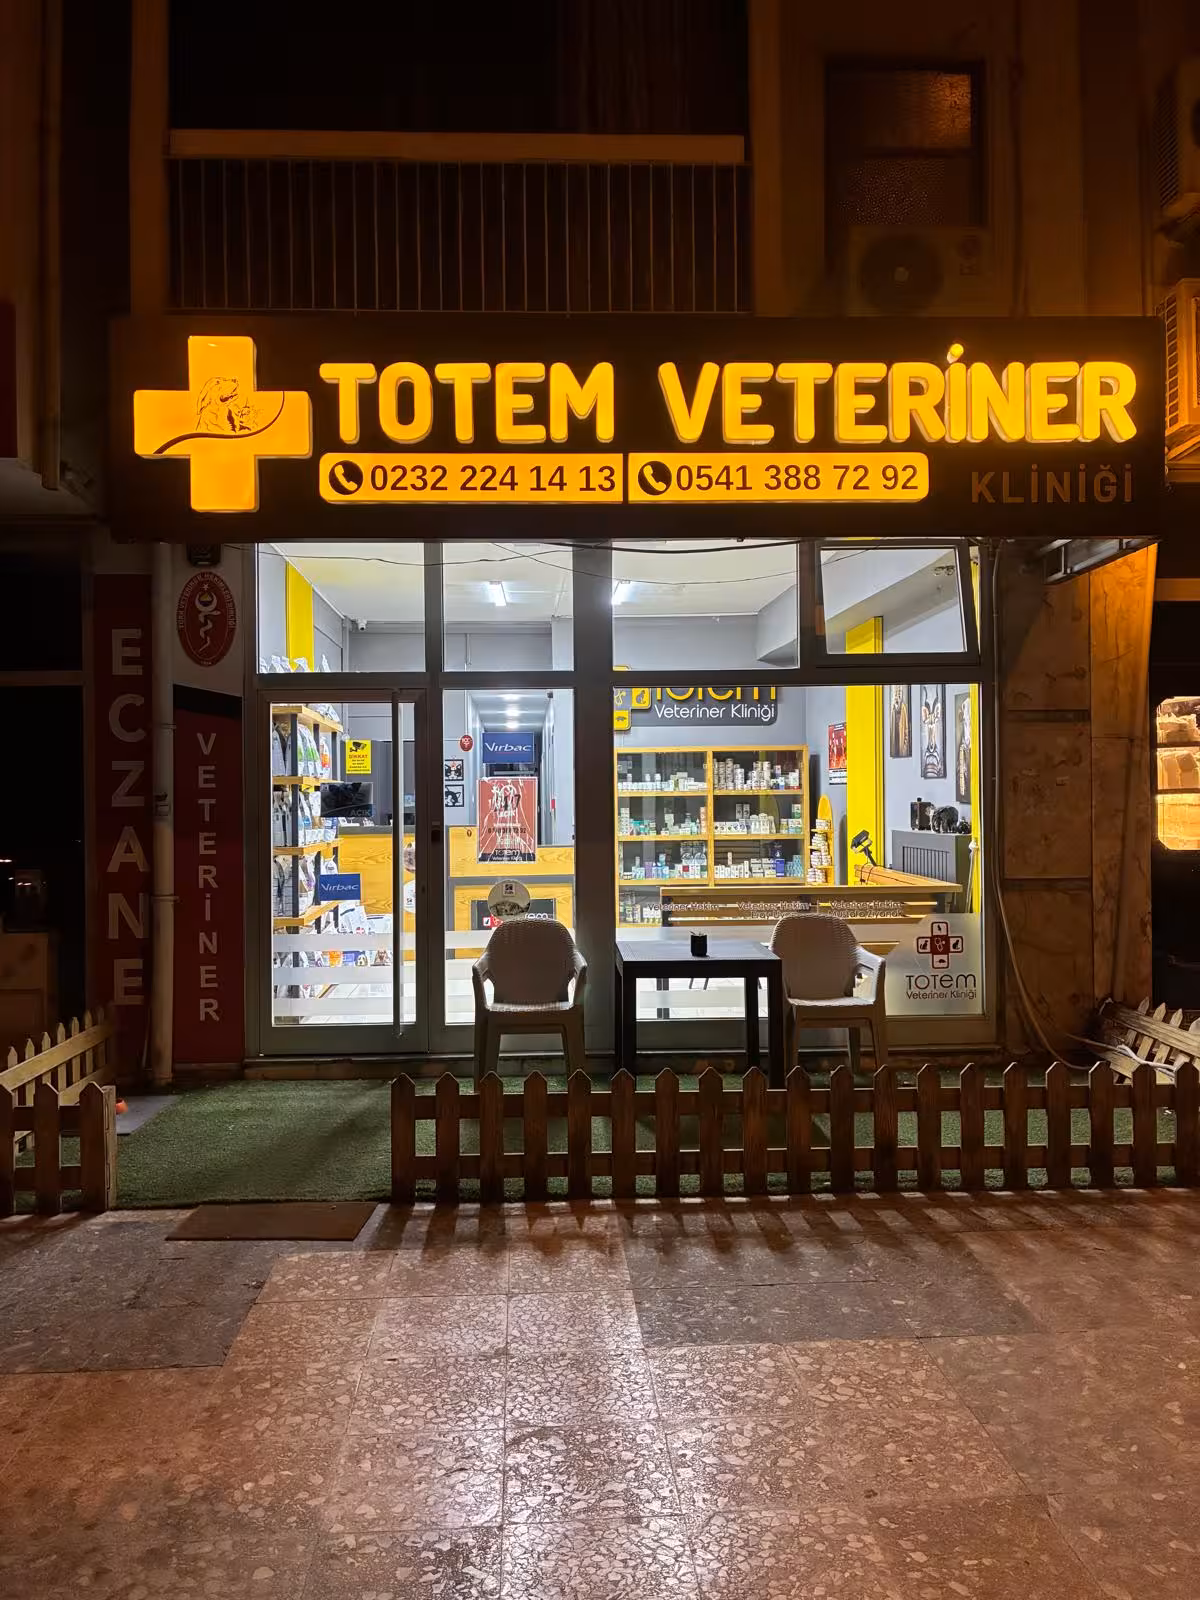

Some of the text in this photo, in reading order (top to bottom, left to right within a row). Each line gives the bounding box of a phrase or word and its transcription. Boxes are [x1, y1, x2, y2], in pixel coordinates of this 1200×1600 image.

[319, 343, 1138, 444] TOTEM VETERİNER
[371, 465, 616, 491] 0232 224 14 13
[676, 465, 919, 491] 0541 388 72 92
[971, 464, 1133, 503] KLİNİĞİ
[655, 704, 775, 722] Veteriner Kliniği
[484, 741, 532, 753] Virbac
[106, 629, 150, 1005] ECZANE
[197, 733, 220, 1021] VETERİNER
[320, 882, 360, 892] Virbac
[648, 902, 689, 911] Veteriner
[906, 990, 977, 1000] Veteriner Kliniği
